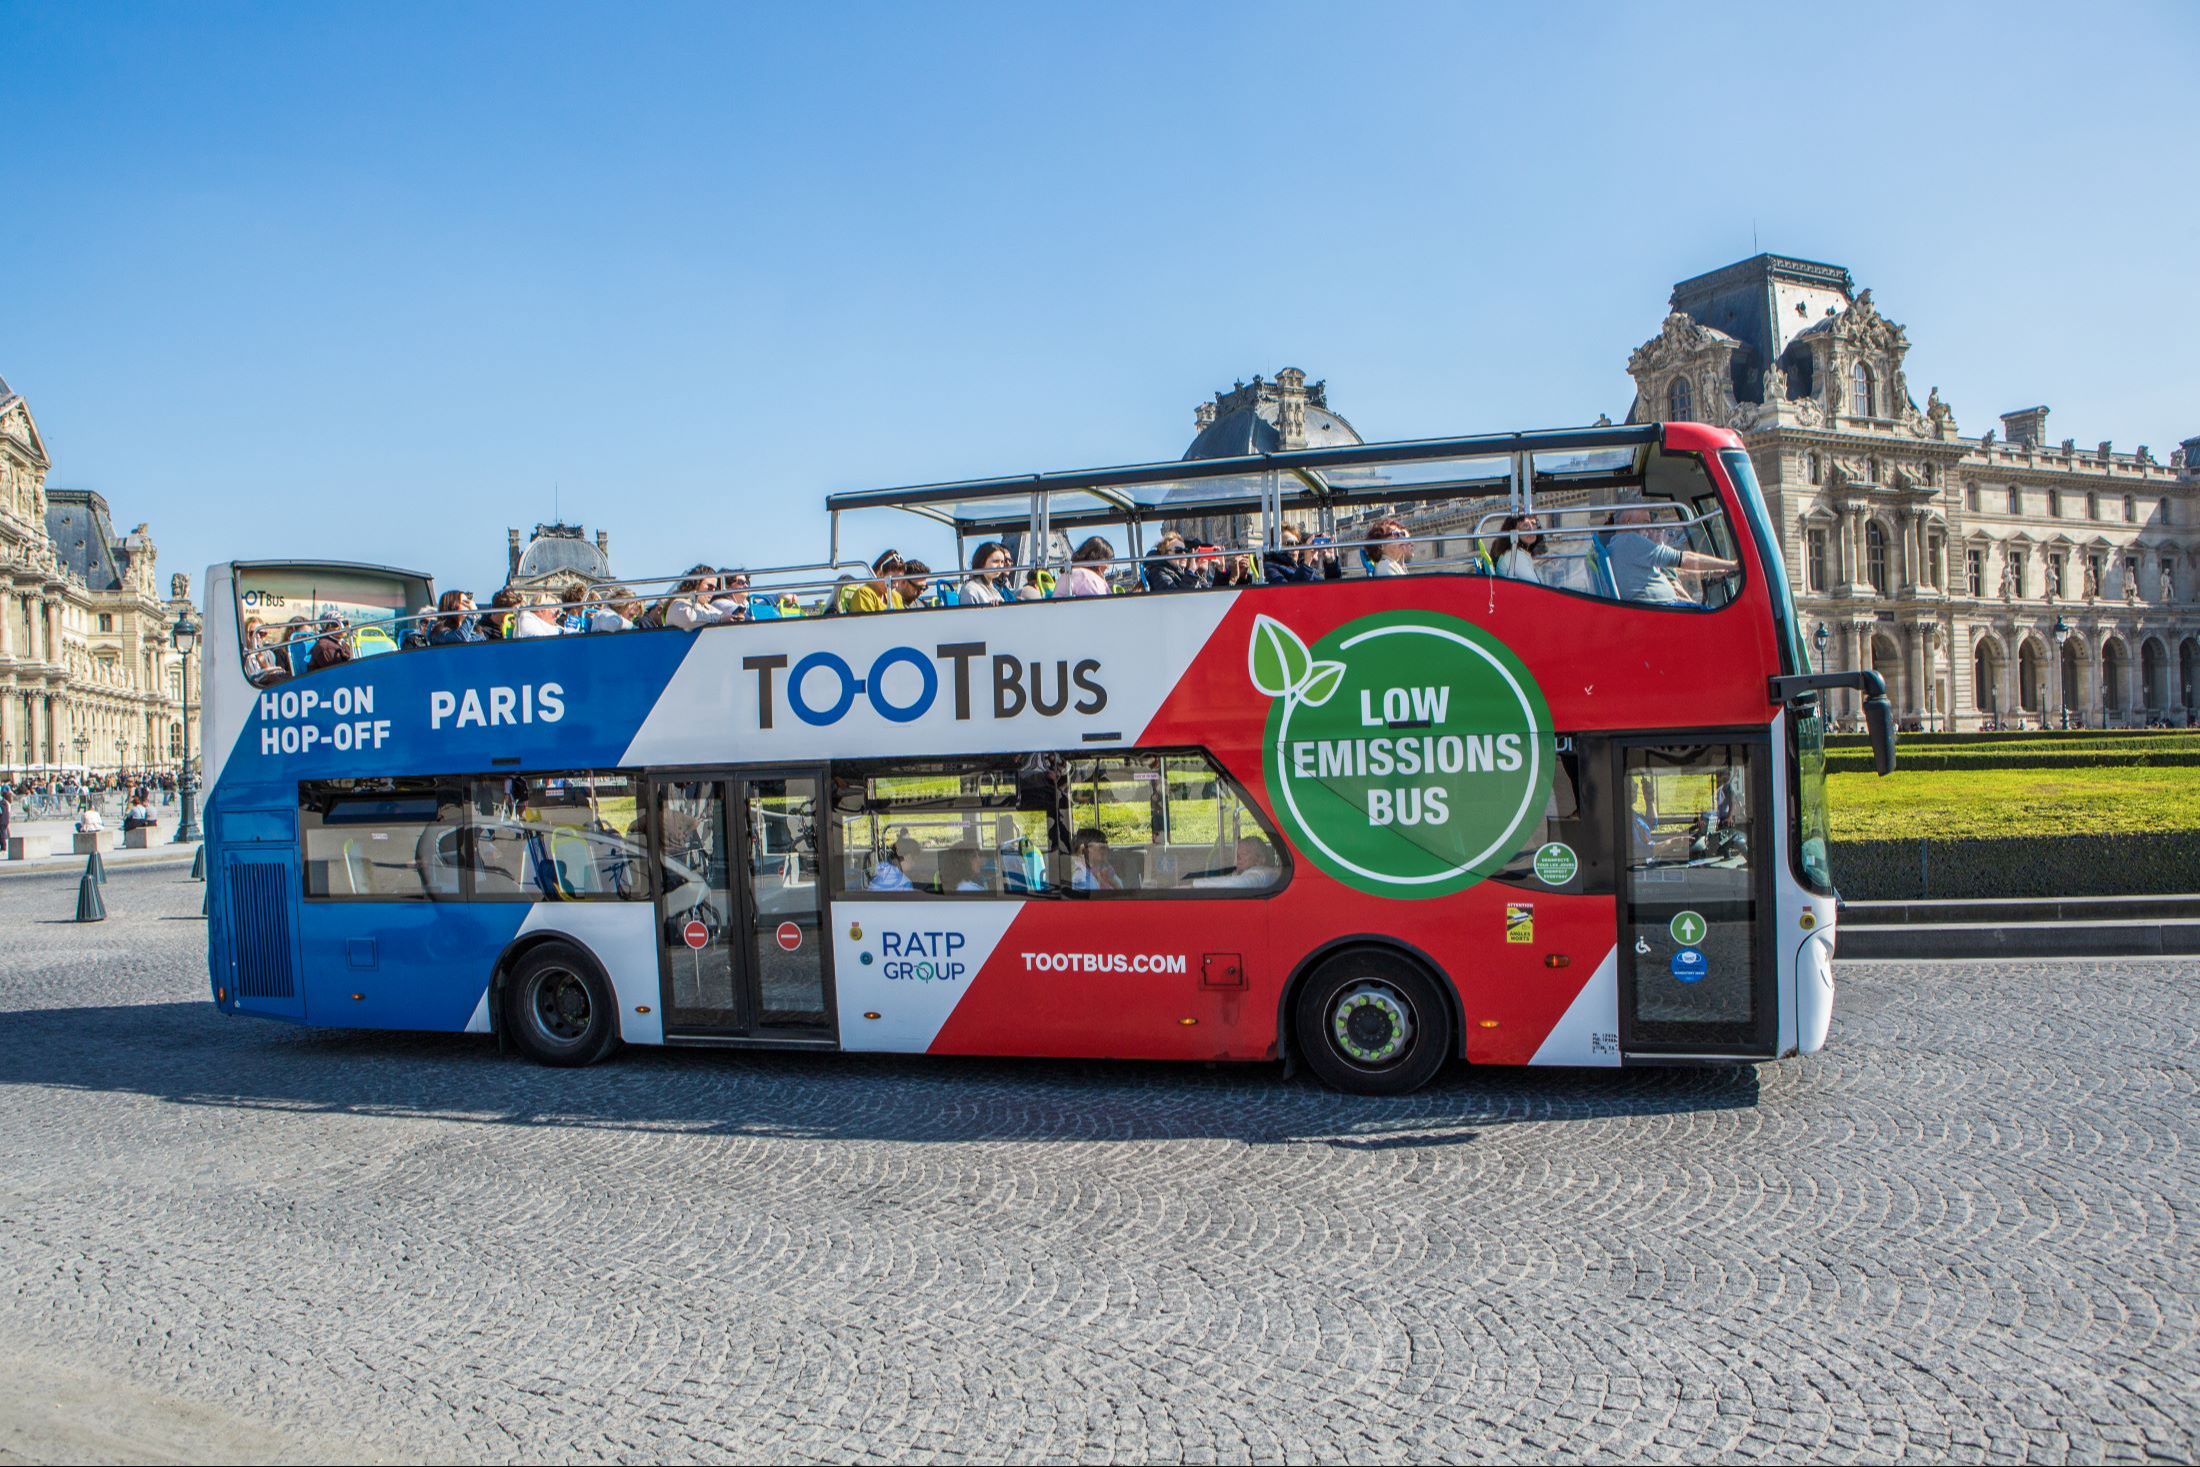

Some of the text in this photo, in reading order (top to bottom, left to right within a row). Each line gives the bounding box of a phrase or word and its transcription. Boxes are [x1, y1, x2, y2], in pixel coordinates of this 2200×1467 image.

[241, 590, 285, 607] OTBUS
[260, 685, 374, 721] HOP-ON
[431, 682, 565, 730] PARIS
[1360, 686, 1450, 726] LOW
[261, 719, 391, 755] HOP-OFF
[1293, 733, 1523, 778] EMISSIONS
[1367, 787, 1450, 826] BUS
[881, 930, 966, 958] RATP
[882, 960, 966, 984] GROUP
[1020, 952, 1187, 974] TOOTBUS.COM
